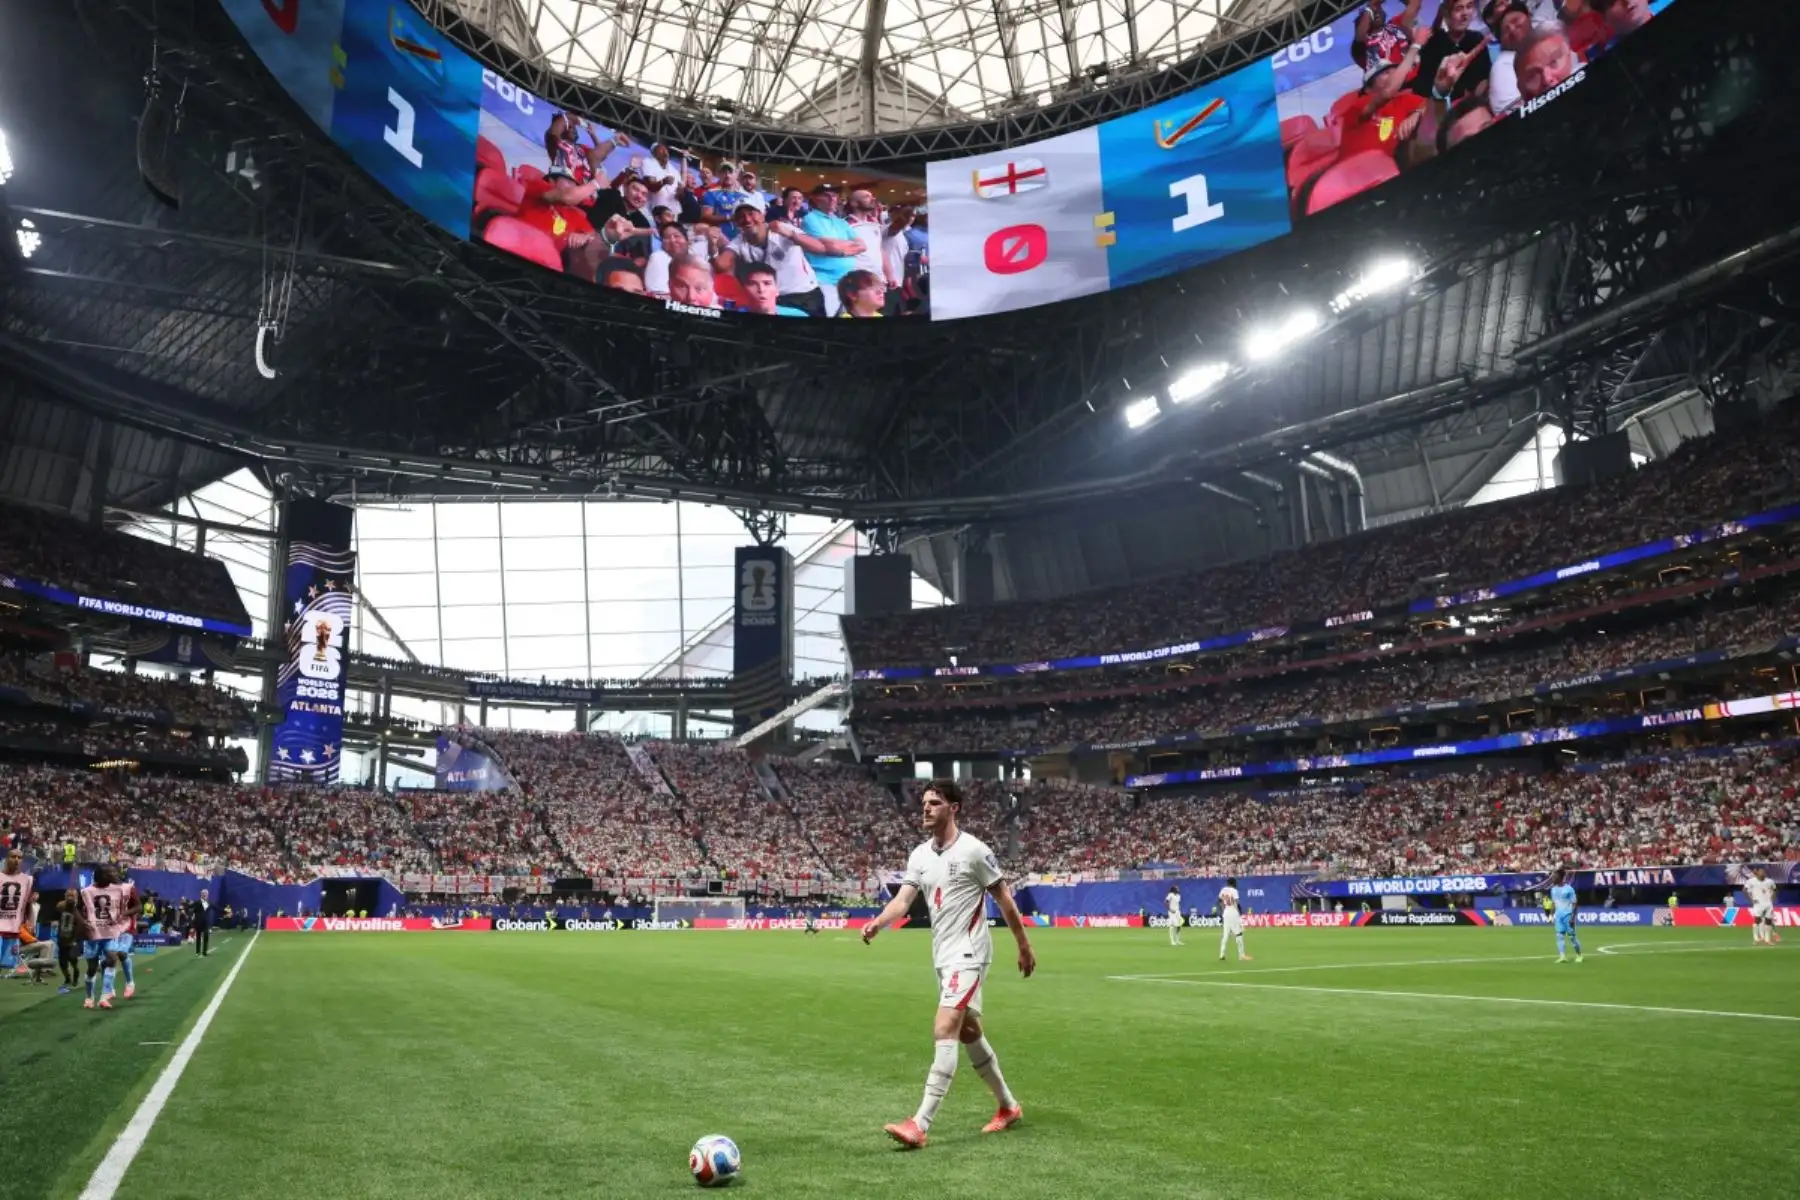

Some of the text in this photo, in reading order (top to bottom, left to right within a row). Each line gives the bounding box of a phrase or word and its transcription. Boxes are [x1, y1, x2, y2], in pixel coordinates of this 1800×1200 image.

[1520, 70, 1587, 119] Hisense
[384, 86, 423, 169] 1
[1169, 173, 1225, 233] 1
[665, 300, 721, 318] Hisense
[78, 596, 103, 609] FIFA
[104, 600, 144, 617] WORLD
[145, 608, 166, 621] CUP
[1325, 610, 1374, 628] ATLANTA
[1100, 654, 1121, 664] FIFA
[1121, 650, 1153, 662] WORLD
[1153, 647, 1170, 657] CUP
[310, 663, 329, 673] FIFA
[934, 666, 980, 677] ATLANTA
[1550, 674, 1602, 690] ATLANTA
[102, 706, 156, 720] ATLANTA
[290, 700, 342, 716] ATLANTA
[1255, 720, 1300, 731] ATLANTA
[1642, 708, 1702, 727] ATLANTA
[1200, 766, 1243, 780] ATLANTA
[1348, 877, 1487, 894] FIFA WORLD CUP 2026
[1594, 869, 1676, 886] ATLANTA
[934, 887, 943, 910] 4
[1247, 889, 1265, 897] FIFA
[496, 918, 547, 930] Globant
[565, 918, 615, 930] Globant
[769, 918, 807, 929] GAMES
[1273, 913, 1307, 926] GAMES
[1310, 913, 1344, 926] GROUP
[1388, 913, 1407, 924] Inter
[1519, 912, 1540, 923] FIFA
[1577, 912, 1597, 923] CUP
